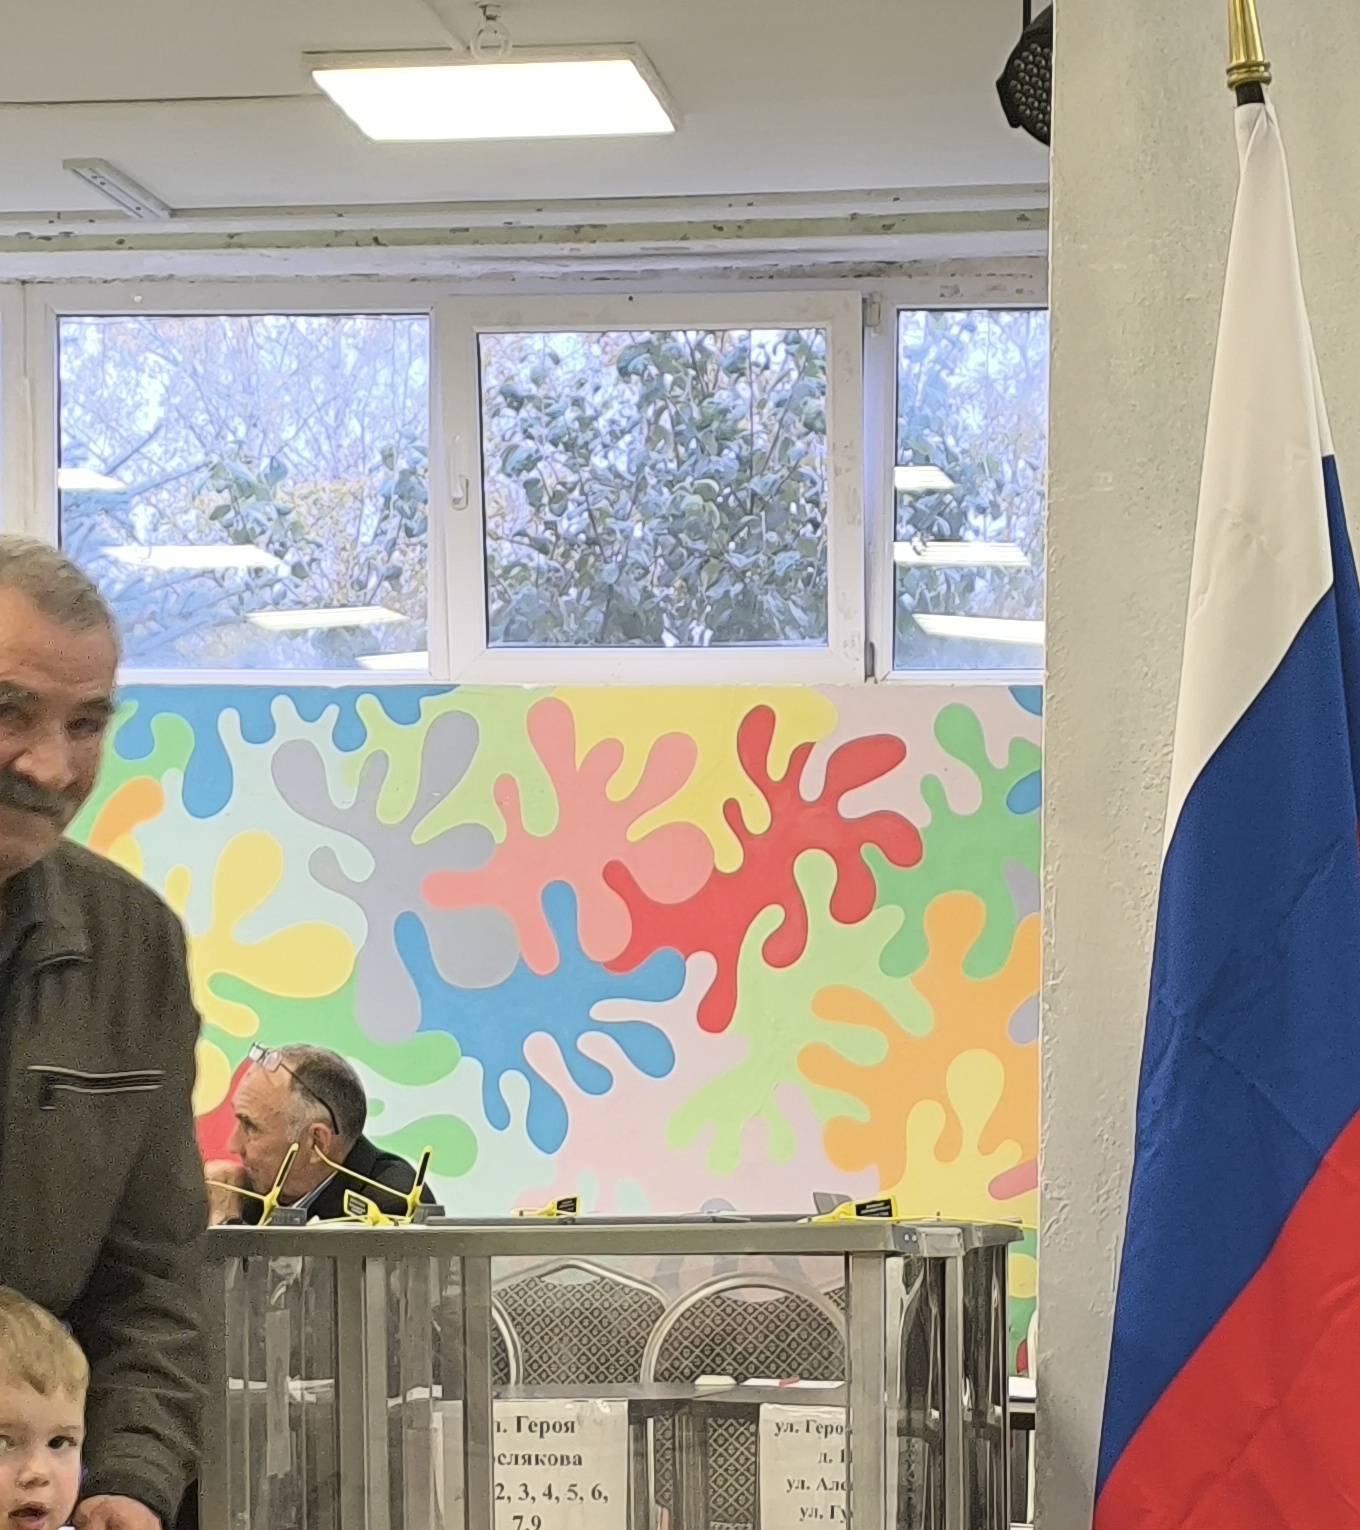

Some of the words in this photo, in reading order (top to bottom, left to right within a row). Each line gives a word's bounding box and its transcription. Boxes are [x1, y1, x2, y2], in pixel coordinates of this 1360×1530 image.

[515, 1415, 576, 1439] Героя
[774, 1421, 800, 1437] ул.
[805, 1419, 852, 1439] Геро
[494, 1452, 583, 1467] слякова
[495, 1482, 512, 1504] 2,
[517, 1482, 536, 1504] 3,
[542, 1482, 560, 1504] 4,
[566, 1483, 584, 1504] 5,
[591, 1482, 609, 1504] 6,
[786, 1478, 811, 1493] ул.
[799, 1506, 824, 1521] ул.
